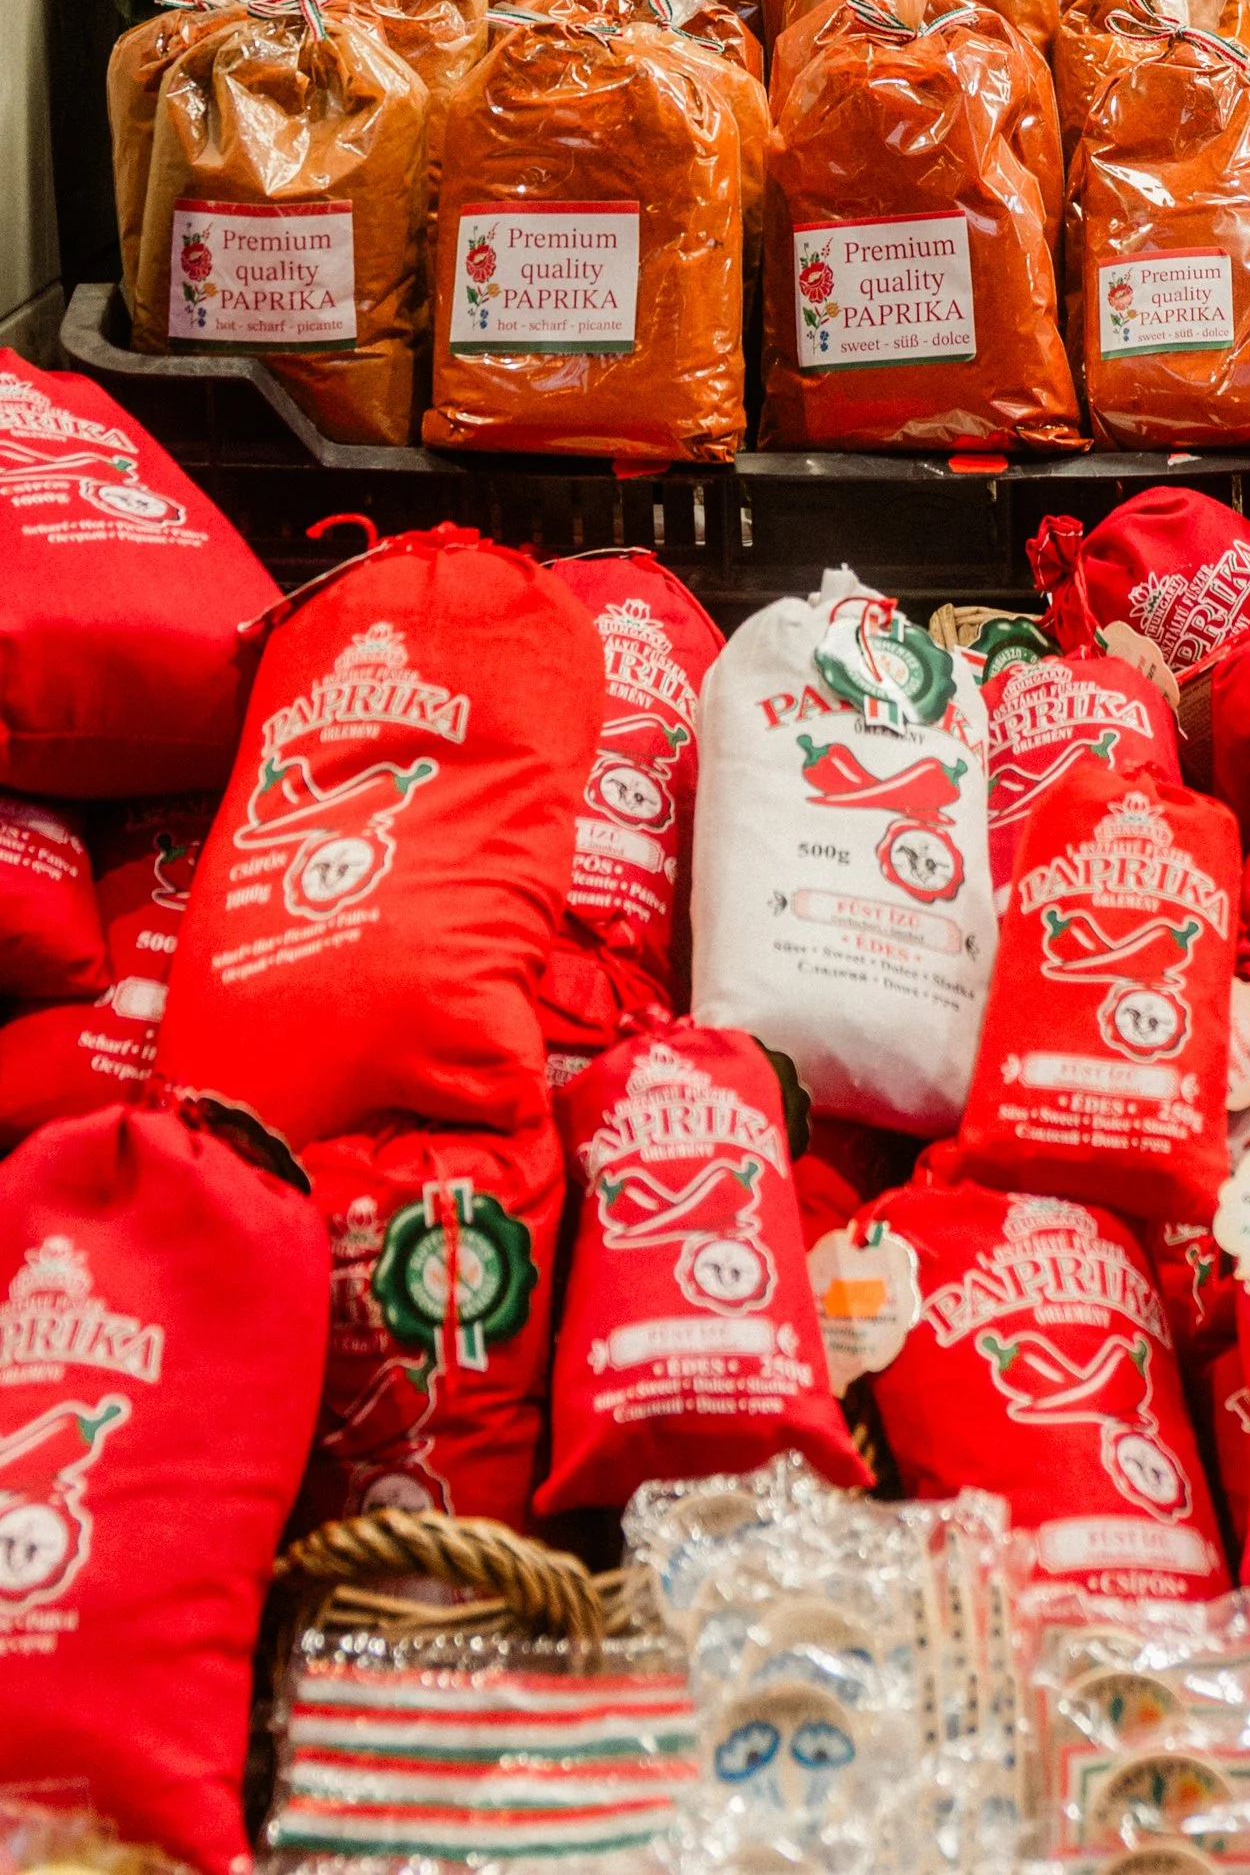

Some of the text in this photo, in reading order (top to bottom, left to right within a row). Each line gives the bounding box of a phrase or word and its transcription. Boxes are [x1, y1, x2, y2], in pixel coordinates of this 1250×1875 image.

[222, 229, 332, 251] Premium
[507, 228, 618, 250] Premium
[843, 236, 957, 265] Premium
[236, 261, 320, 284] quality
[520, 258, 604, 284] quality
[1140, 266, 1222, 285] Premium
[859, 268, 945, 301] quality
[1151, 285, 1213, 306] quality
[219, 288, 338, 312] PAPRIKA
[502, 288, 619, 311] PAPRIKA
[841, 297, 965, 329] PAPRIKA
[1137, 305, 1226, 327] PAPRIKA
[214, 318, 344, 334] hot scharf picante
[496, 318, 623, 335] hot scharf picante
[1137, 326, 1230, 343] sweet süß dolce
[840, 331, 971, 354] sweet süß dolce
[1149, 577, 1181, 637] HUNGARY
[262, 677, 472, 758] PAPRIKA
[798, 843, 851, 866] 500g
[1018, 851, 1229, 942] PAPRIKA
[921, 1255, 1173, 1351] PAPRIKA
